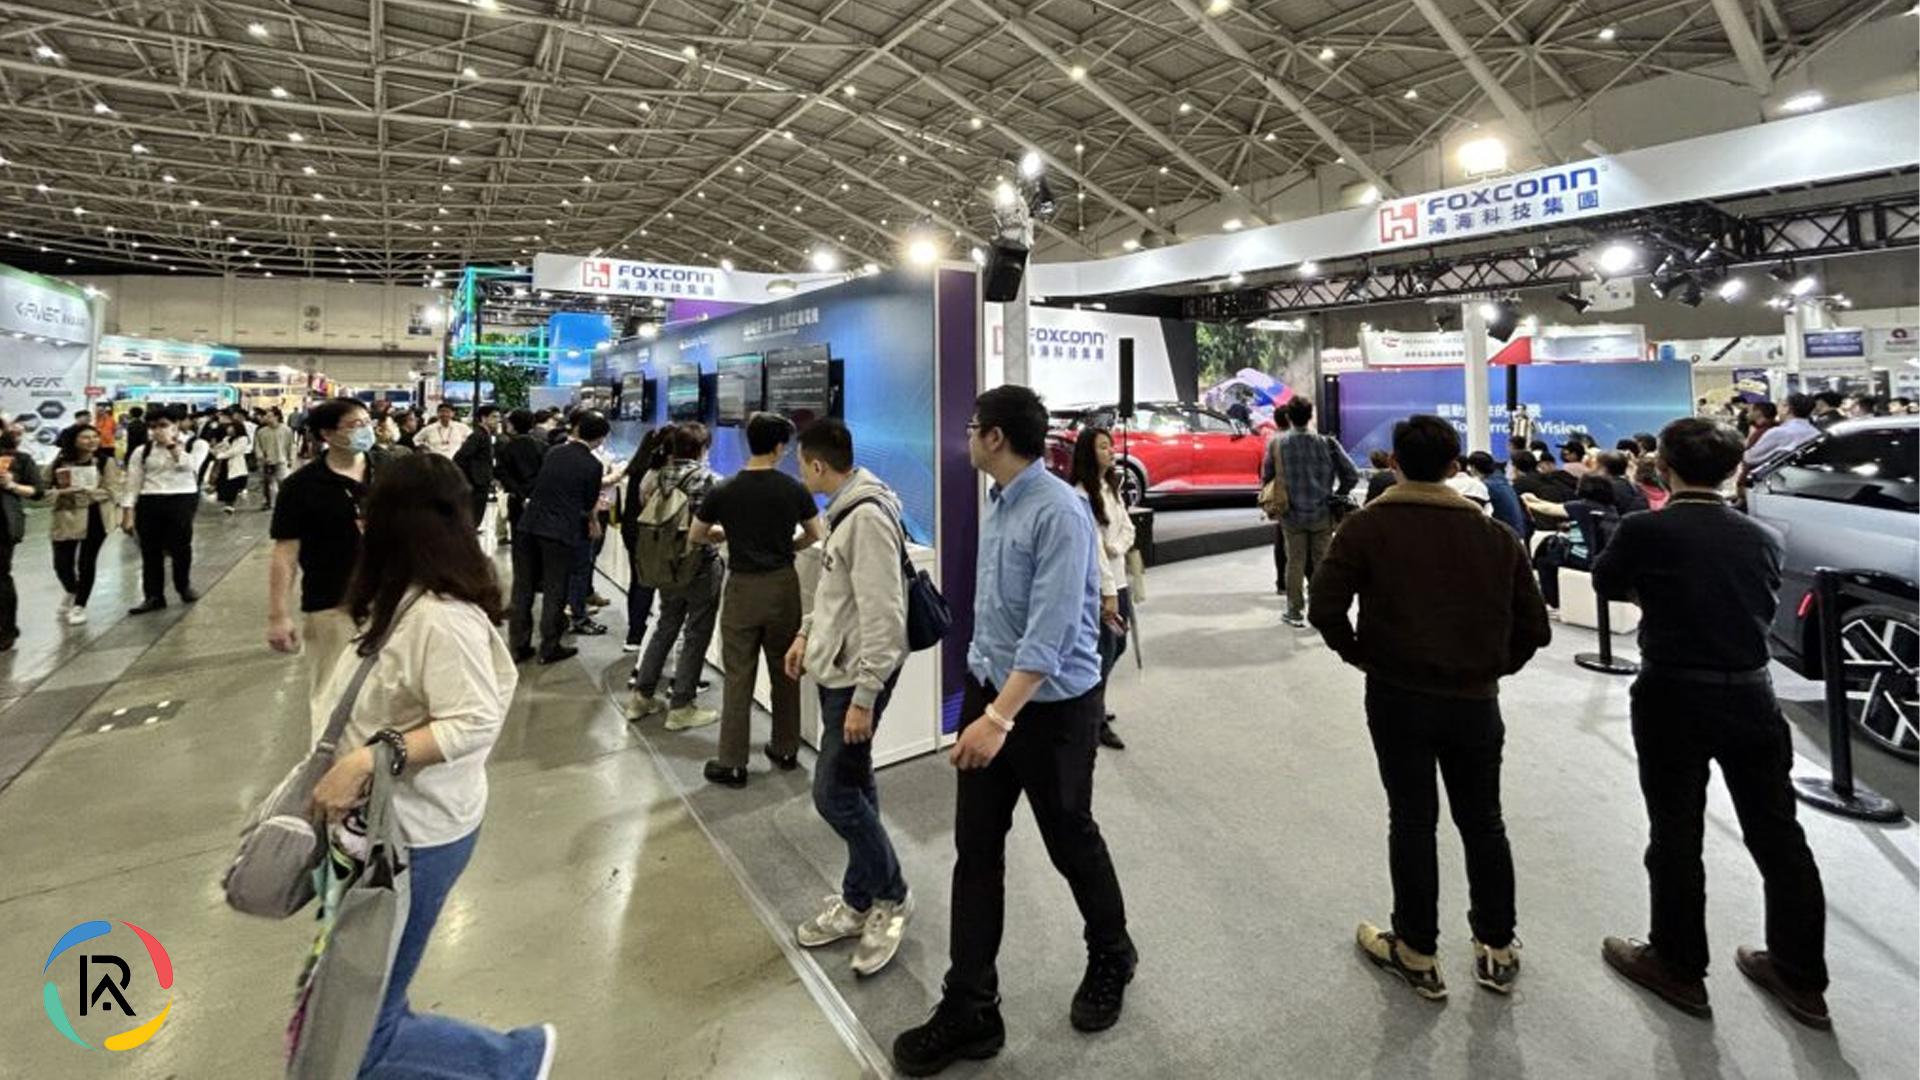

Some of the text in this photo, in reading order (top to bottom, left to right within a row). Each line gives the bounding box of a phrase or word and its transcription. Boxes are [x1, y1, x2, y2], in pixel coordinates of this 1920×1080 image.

[1427, 166, 1599, 215] FOXCONN
[1428, 190, 1599, 235] 鴻海科技集團
[618, 264, 714, 283] FOXCONN
[1538, 421, 1588, 434] Vision
